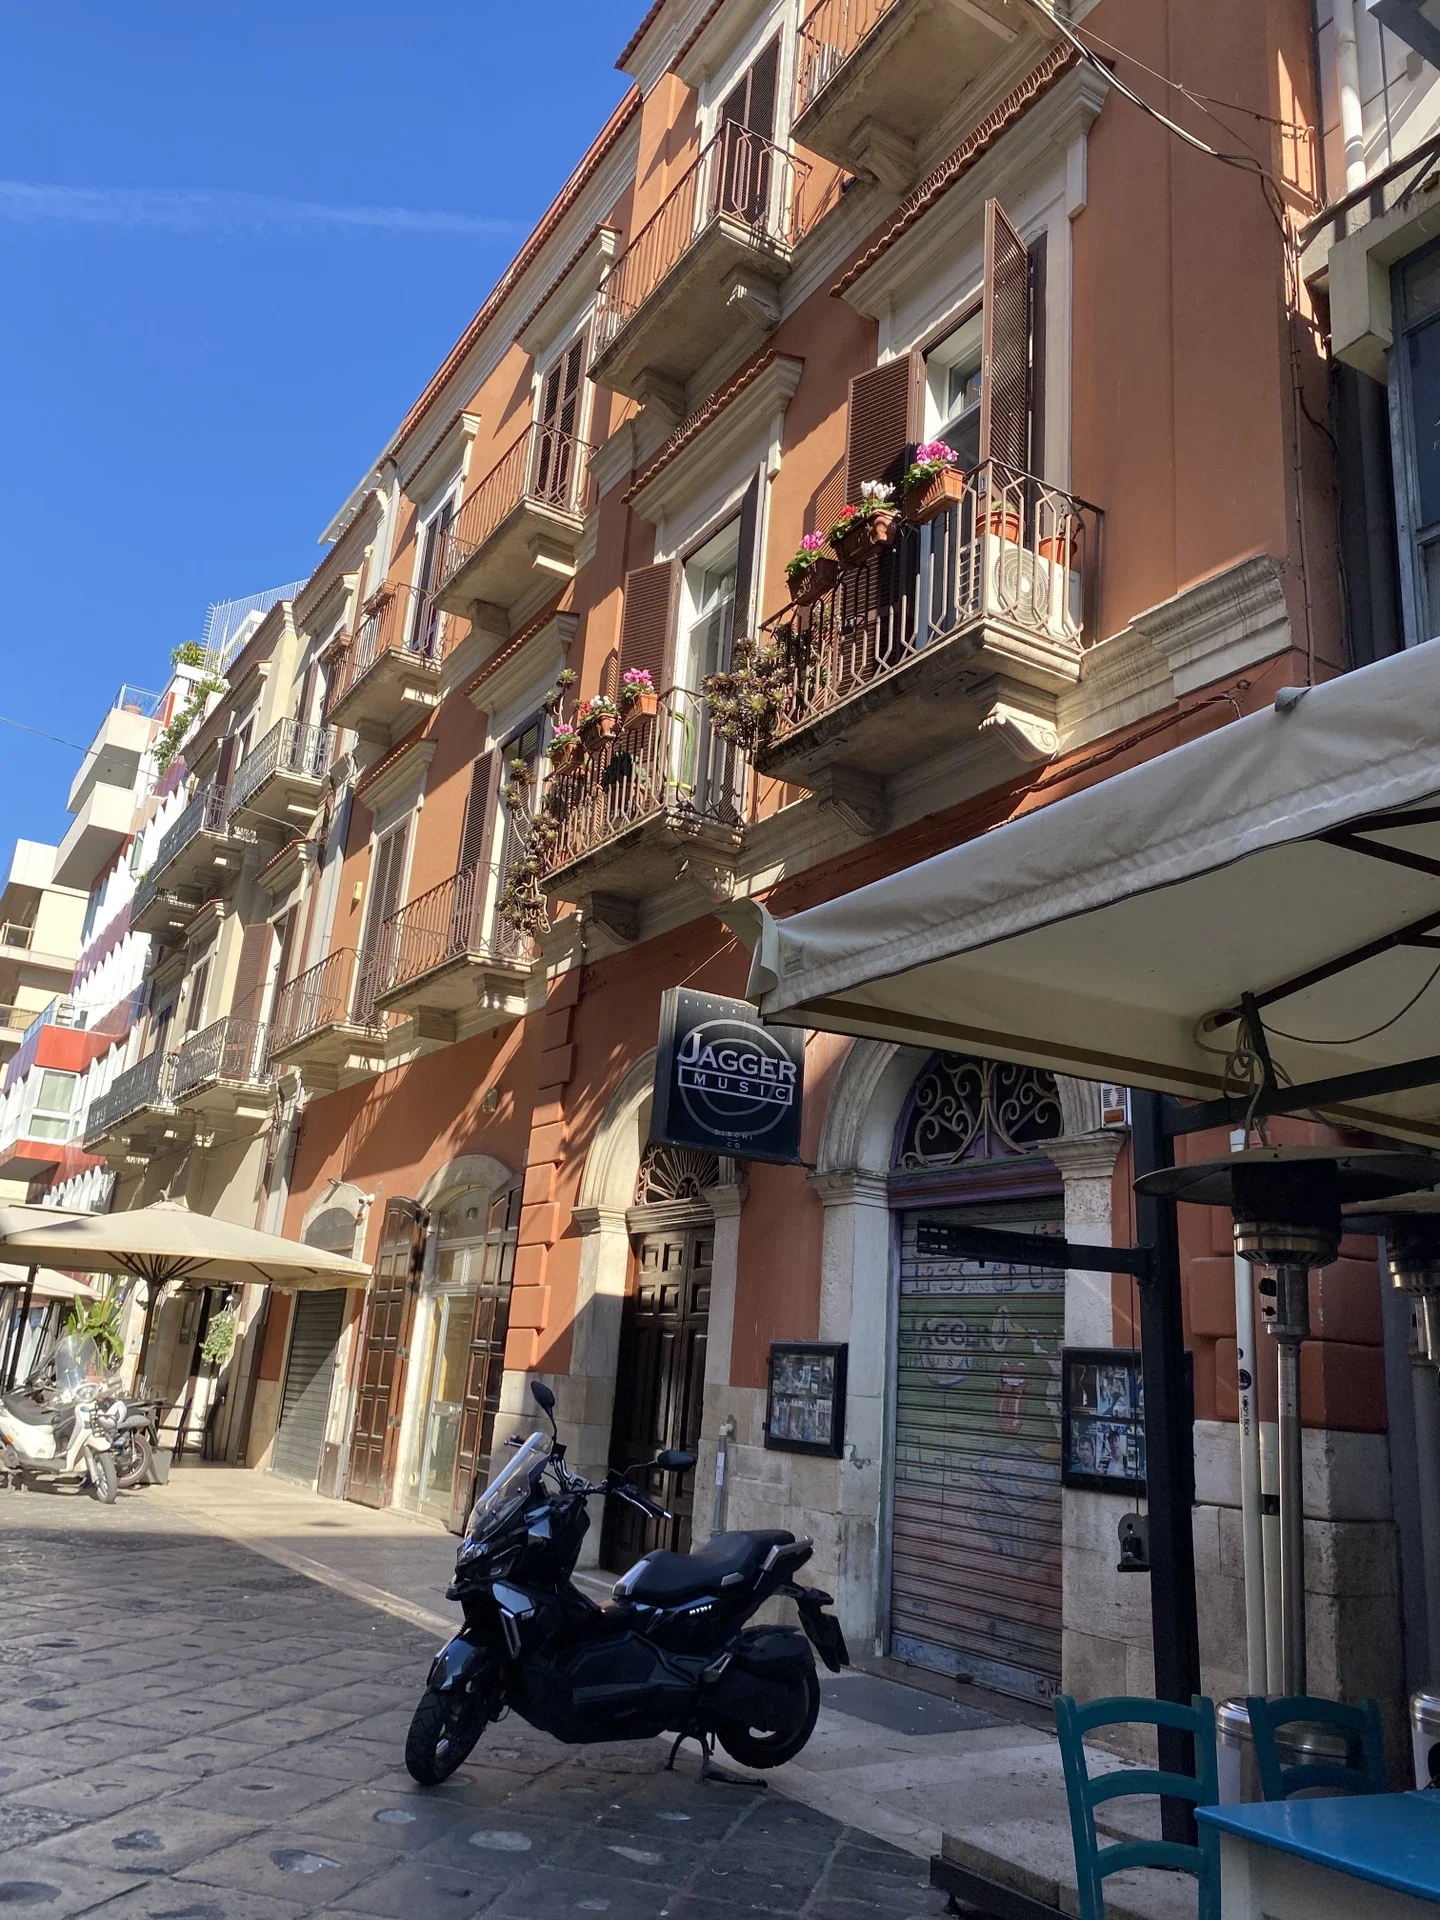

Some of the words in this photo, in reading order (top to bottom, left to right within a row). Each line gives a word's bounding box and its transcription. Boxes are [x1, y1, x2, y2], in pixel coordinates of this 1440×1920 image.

[684, 998, 737, 1014] SINCE
[676, 1032, 797, 1083] JAGGER
[693, 1072, 787, 1100] MUSIC
[714, 1129, 753, 1141] DISCHI
